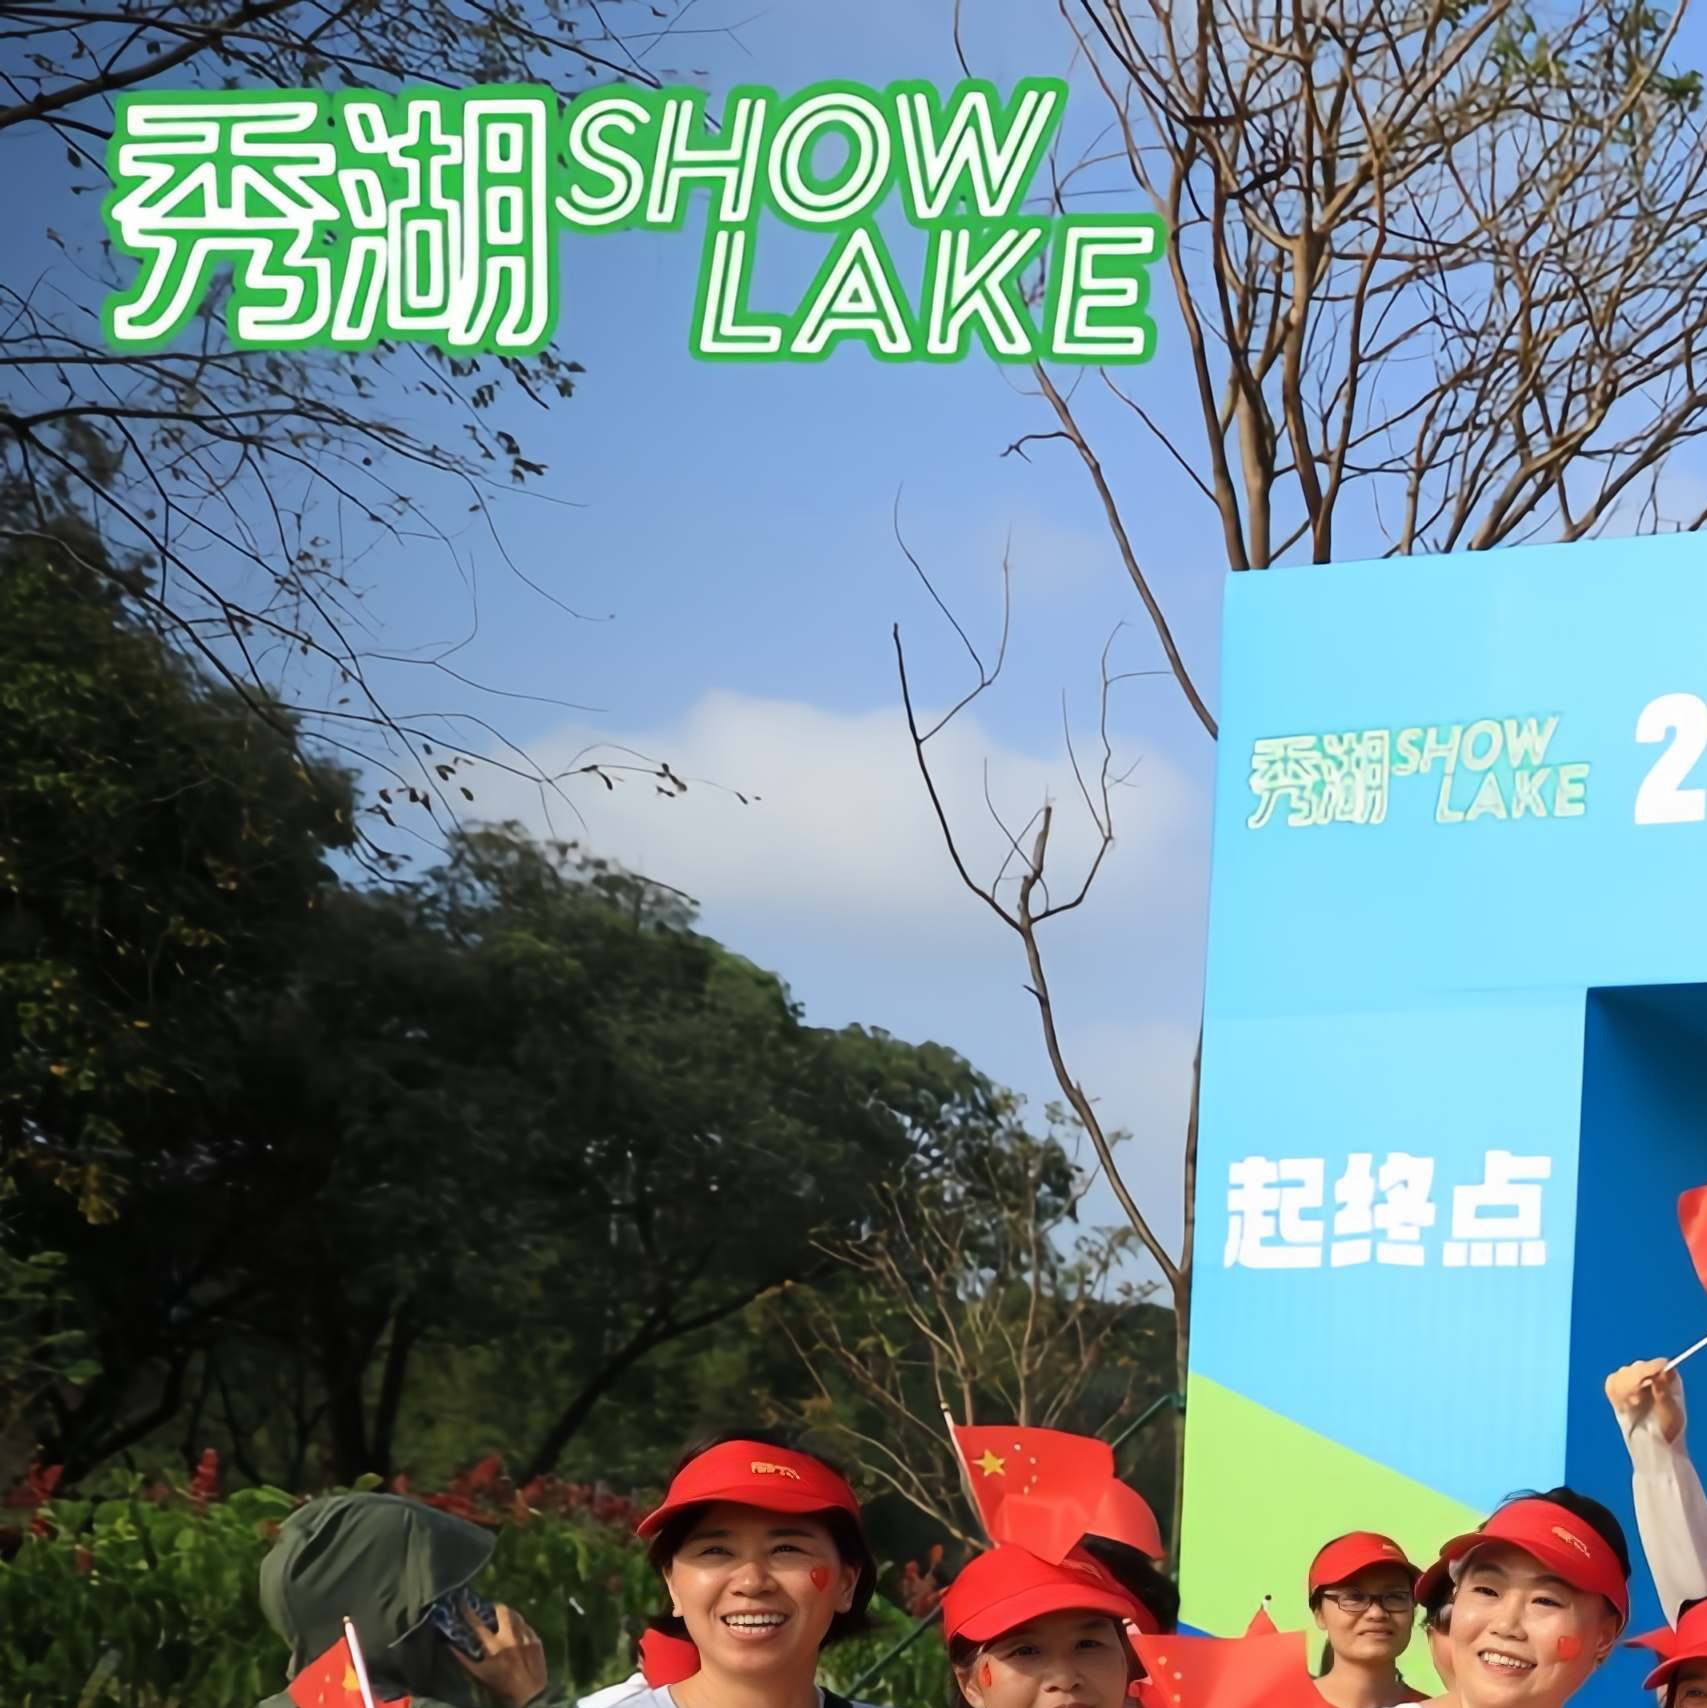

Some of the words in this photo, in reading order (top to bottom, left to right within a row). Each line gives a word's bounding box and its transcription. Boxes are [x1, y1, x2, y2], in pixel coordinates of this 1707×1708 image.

[1246, 729, 1391, 830] 秀湖
[1391, 713, 1562, 777] SHOW
[1434, 761, 1591, 824] LAKE
[1223, 1150, 1552, 1268] 起终点
